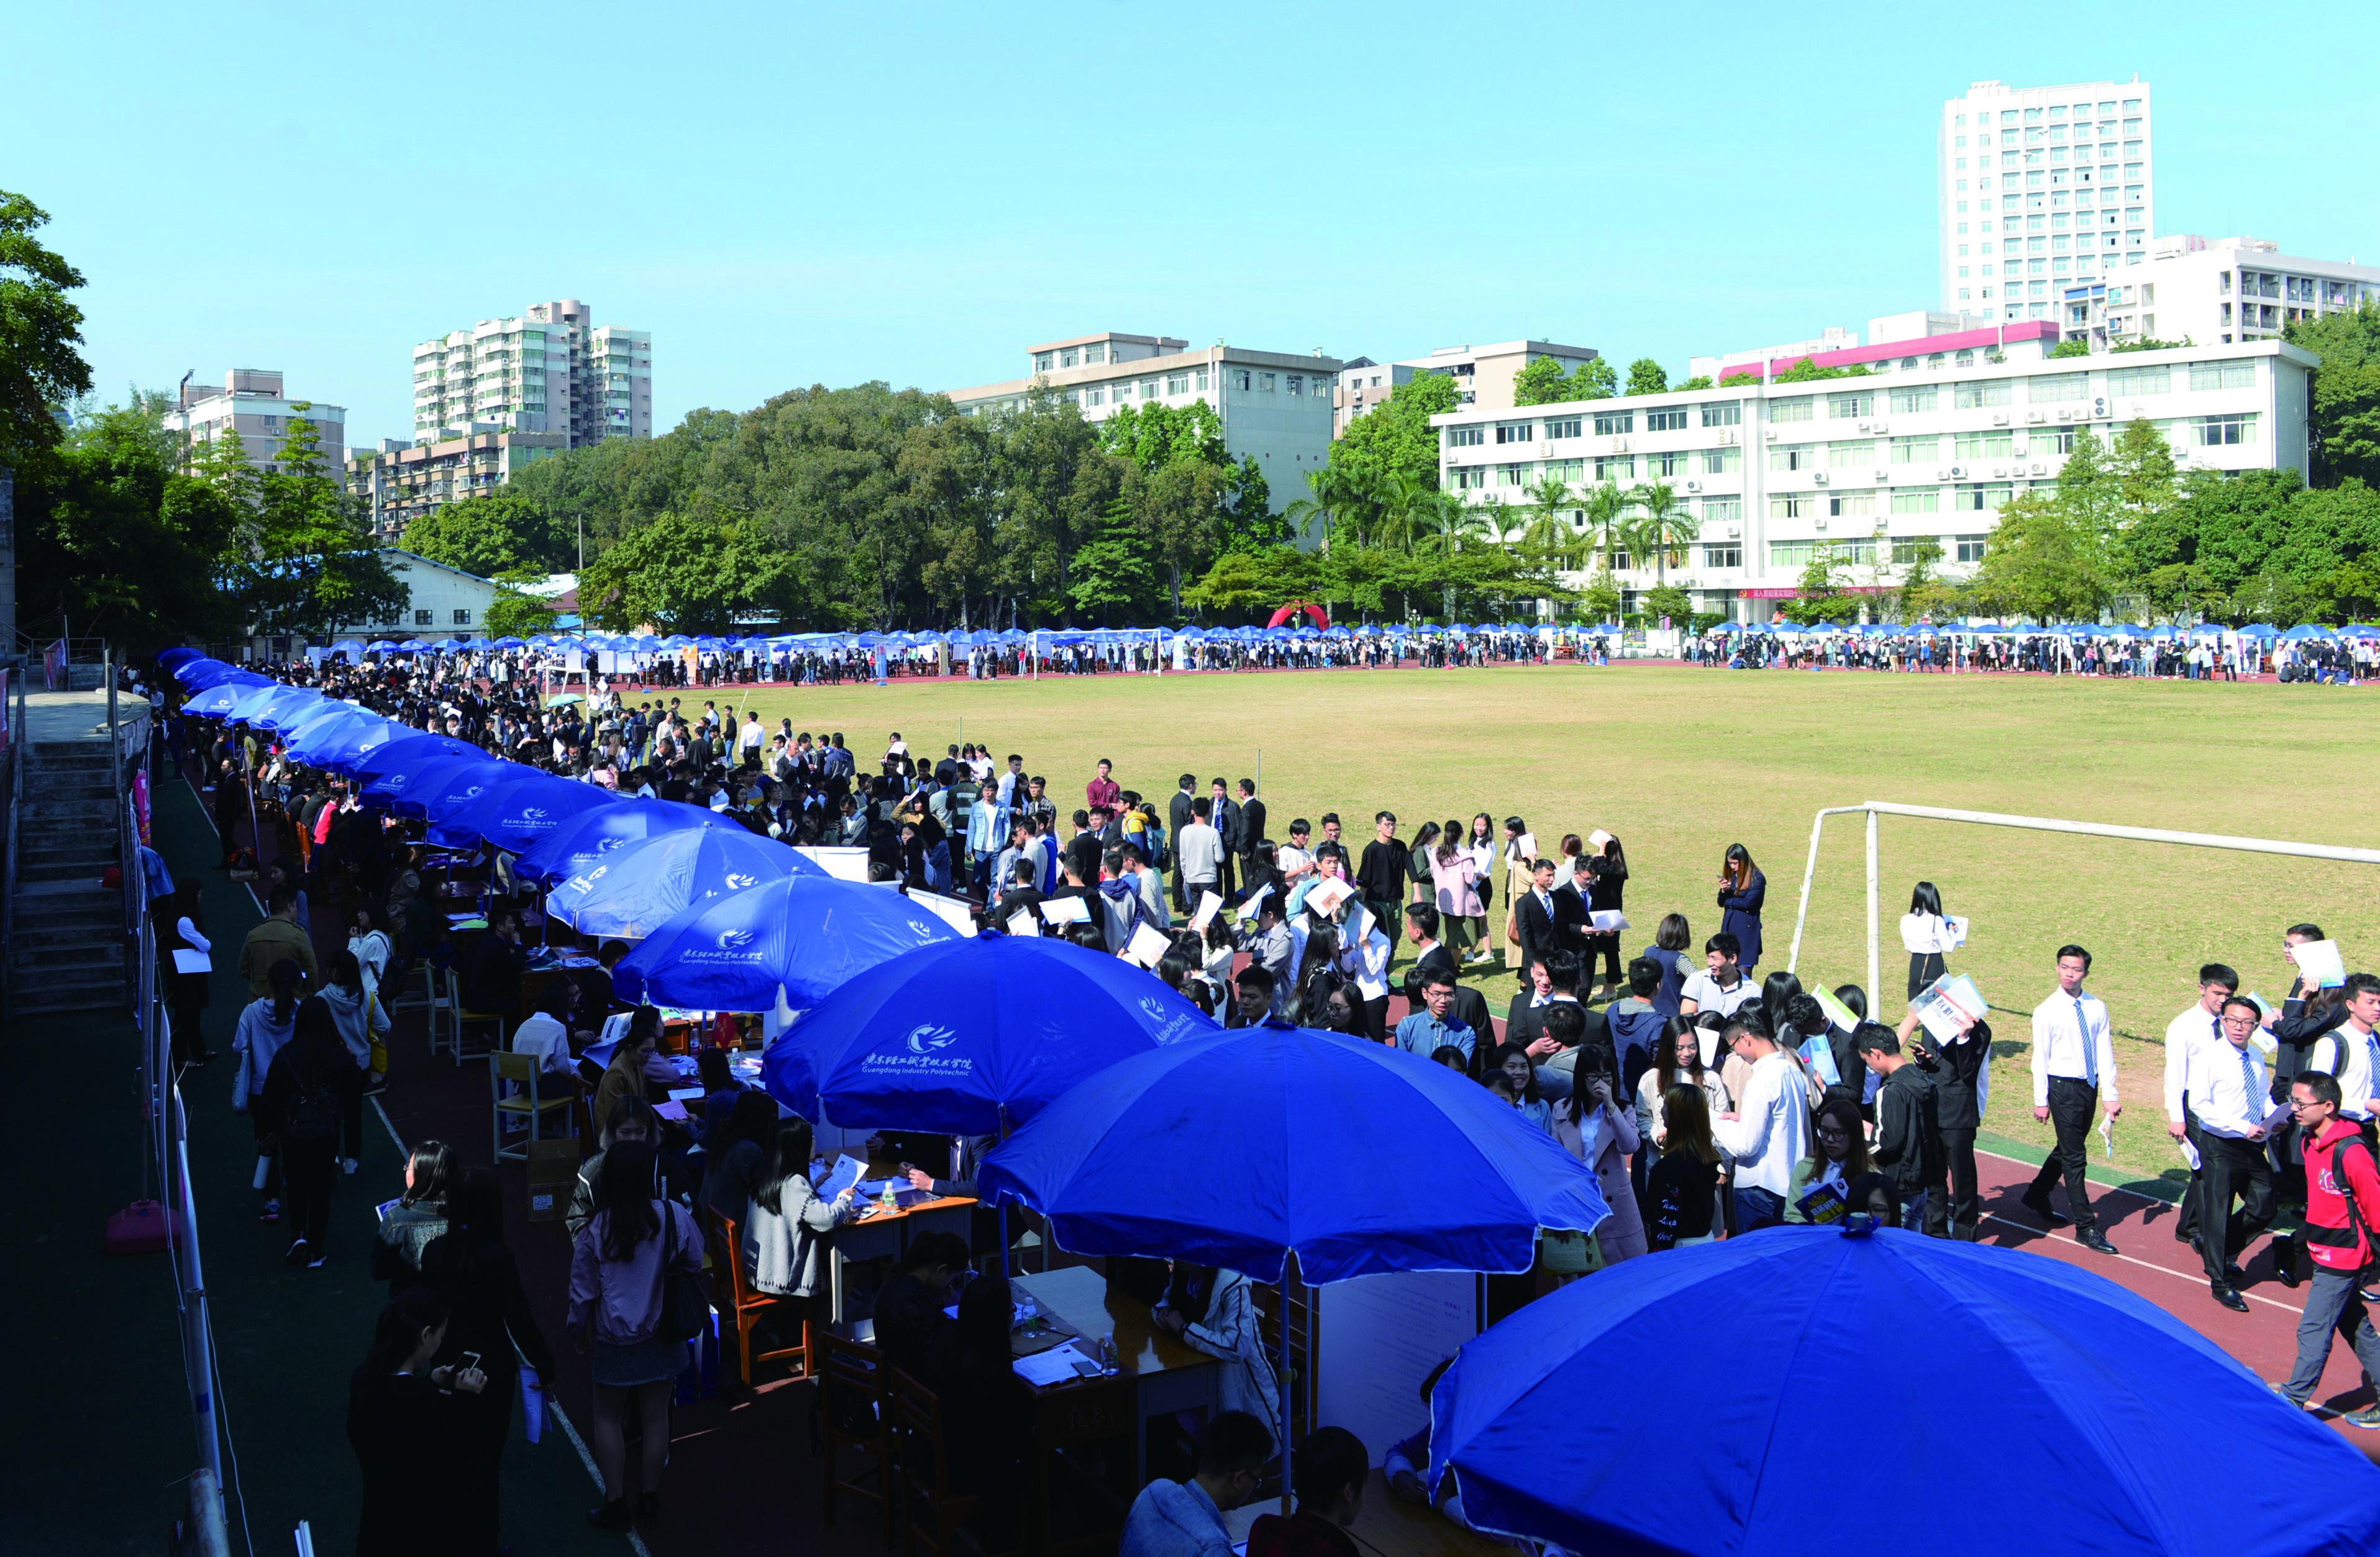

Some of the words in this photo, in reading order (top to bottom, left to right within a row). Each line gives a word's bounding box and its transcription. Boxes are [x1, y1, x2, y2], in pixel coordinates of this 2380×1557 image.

[862, 1066, 901, 1075] Guangdong
[901, 1067, 930, 1076] Industry
[930, 1068, 970, 1077] Polytechnic
